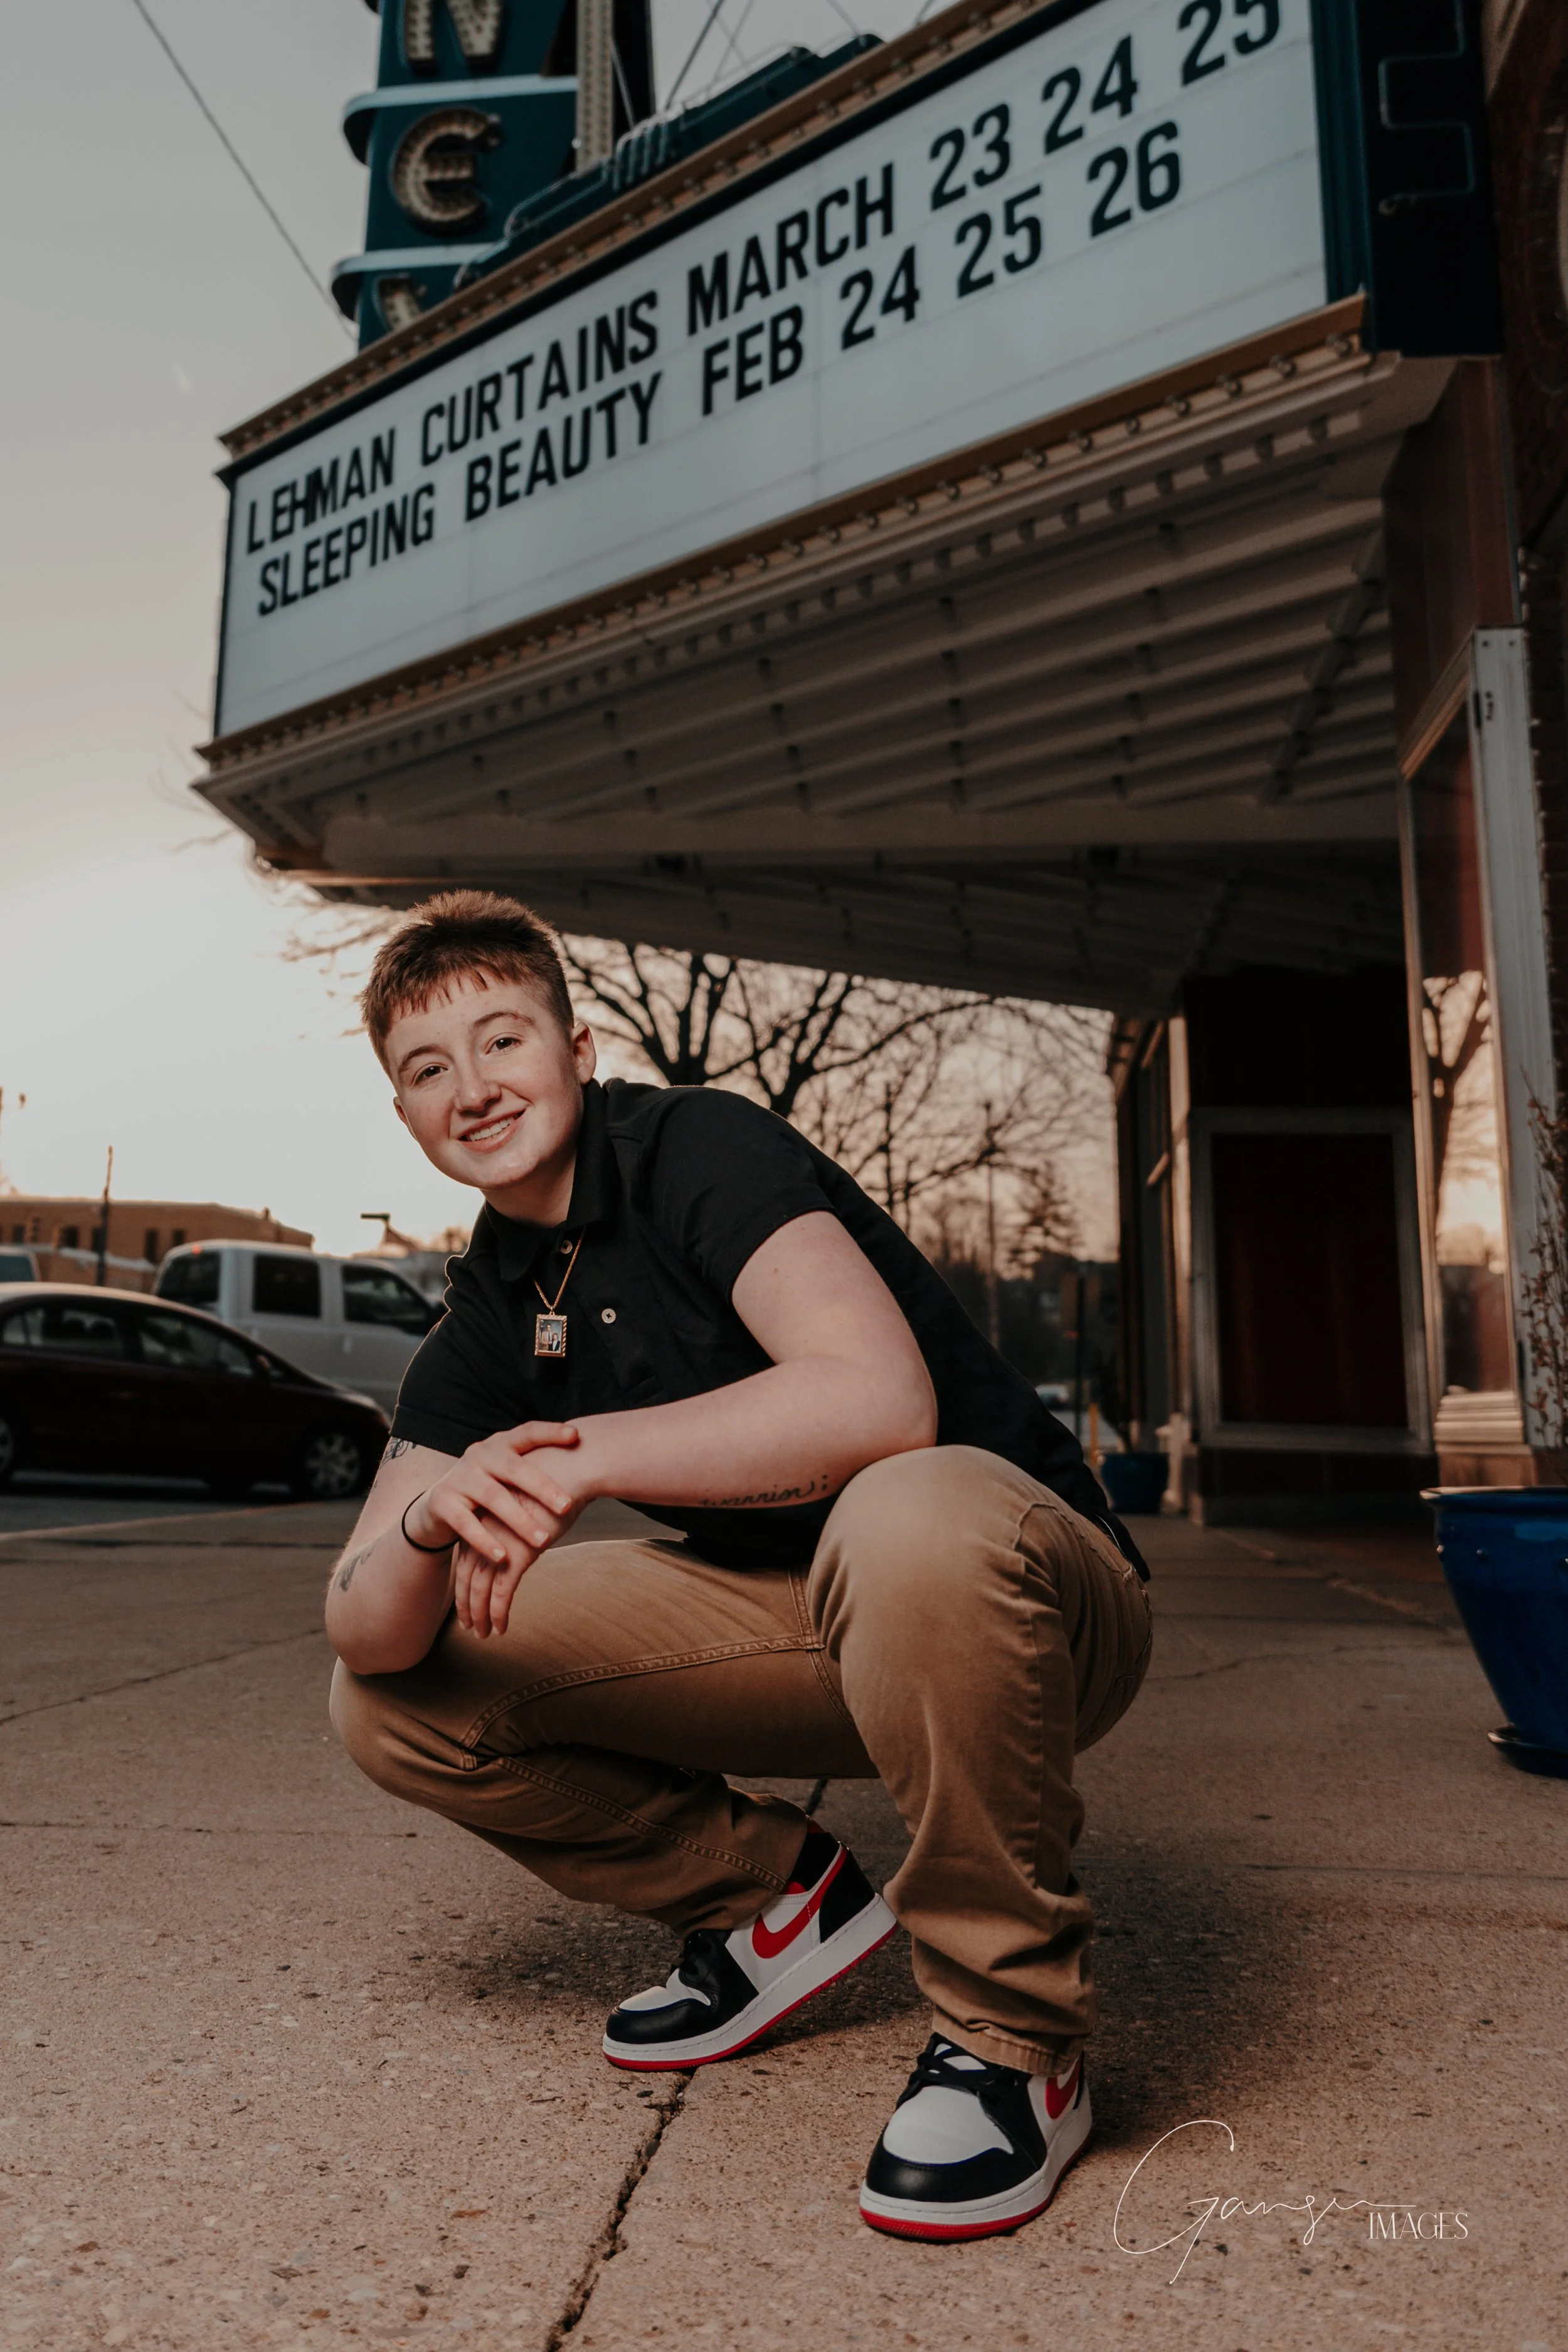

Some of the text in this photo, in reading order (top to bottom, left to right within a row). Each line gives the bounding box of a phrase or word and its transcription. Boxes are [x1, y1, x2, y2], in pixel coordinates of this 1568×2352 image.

[246, 0, 1280, 554] LEHMAN CURTAINS MARCH 23 24 25
[258, 121, 1181, 617] SLEEPING BEAUTY FEB 24 25 26
